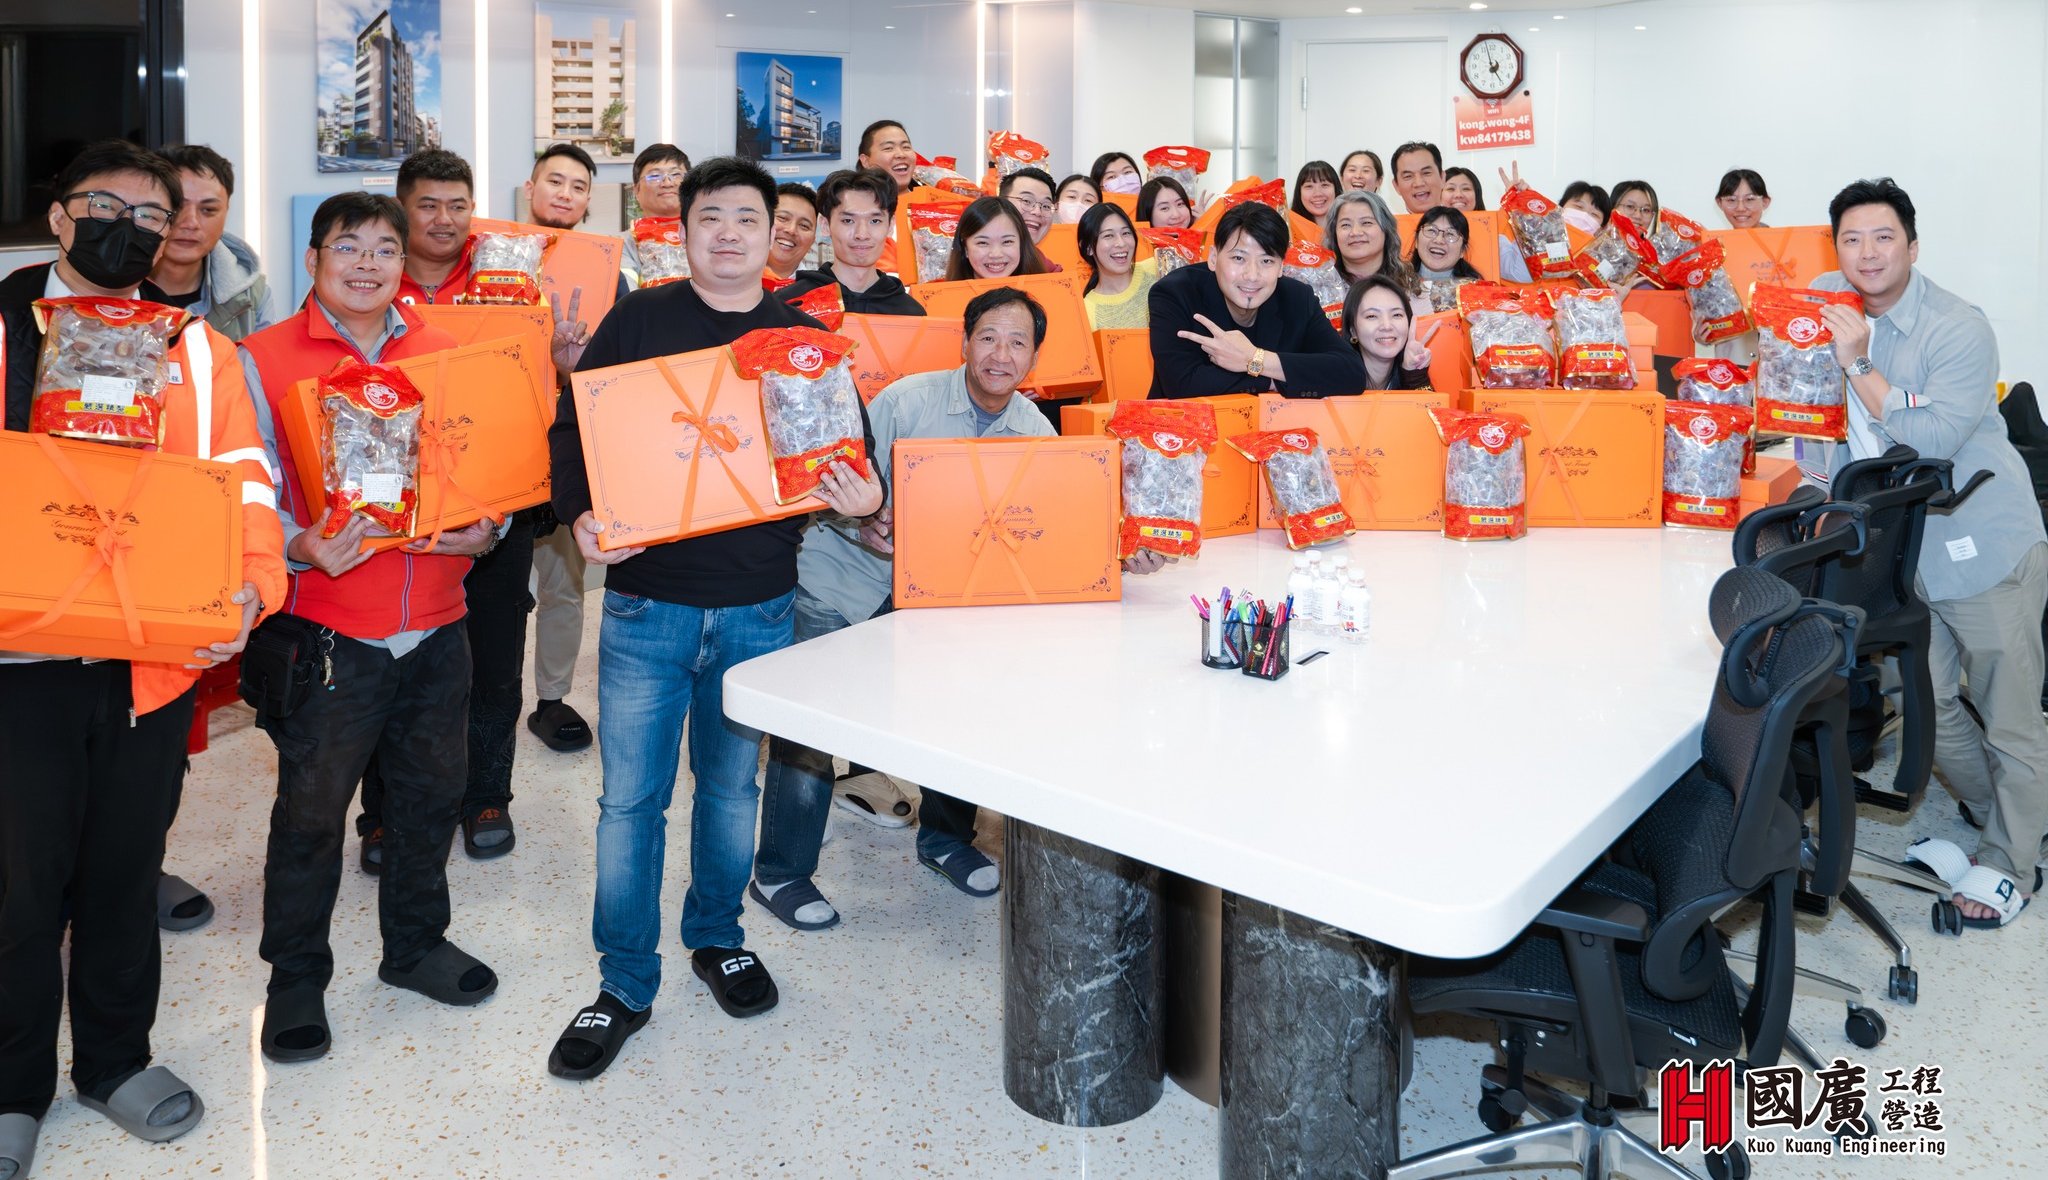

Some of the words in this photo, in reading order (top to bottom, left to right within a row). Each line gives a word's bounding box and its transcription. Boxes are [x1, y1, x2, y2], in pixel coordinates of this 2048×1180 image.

[1459, 115, 1530, 130] kong.wong-4F
[1460, 130, 1531, 145] kw84179438
[720, 956, 754, 976] GP
[574, 1012, 612, 1028] GP
